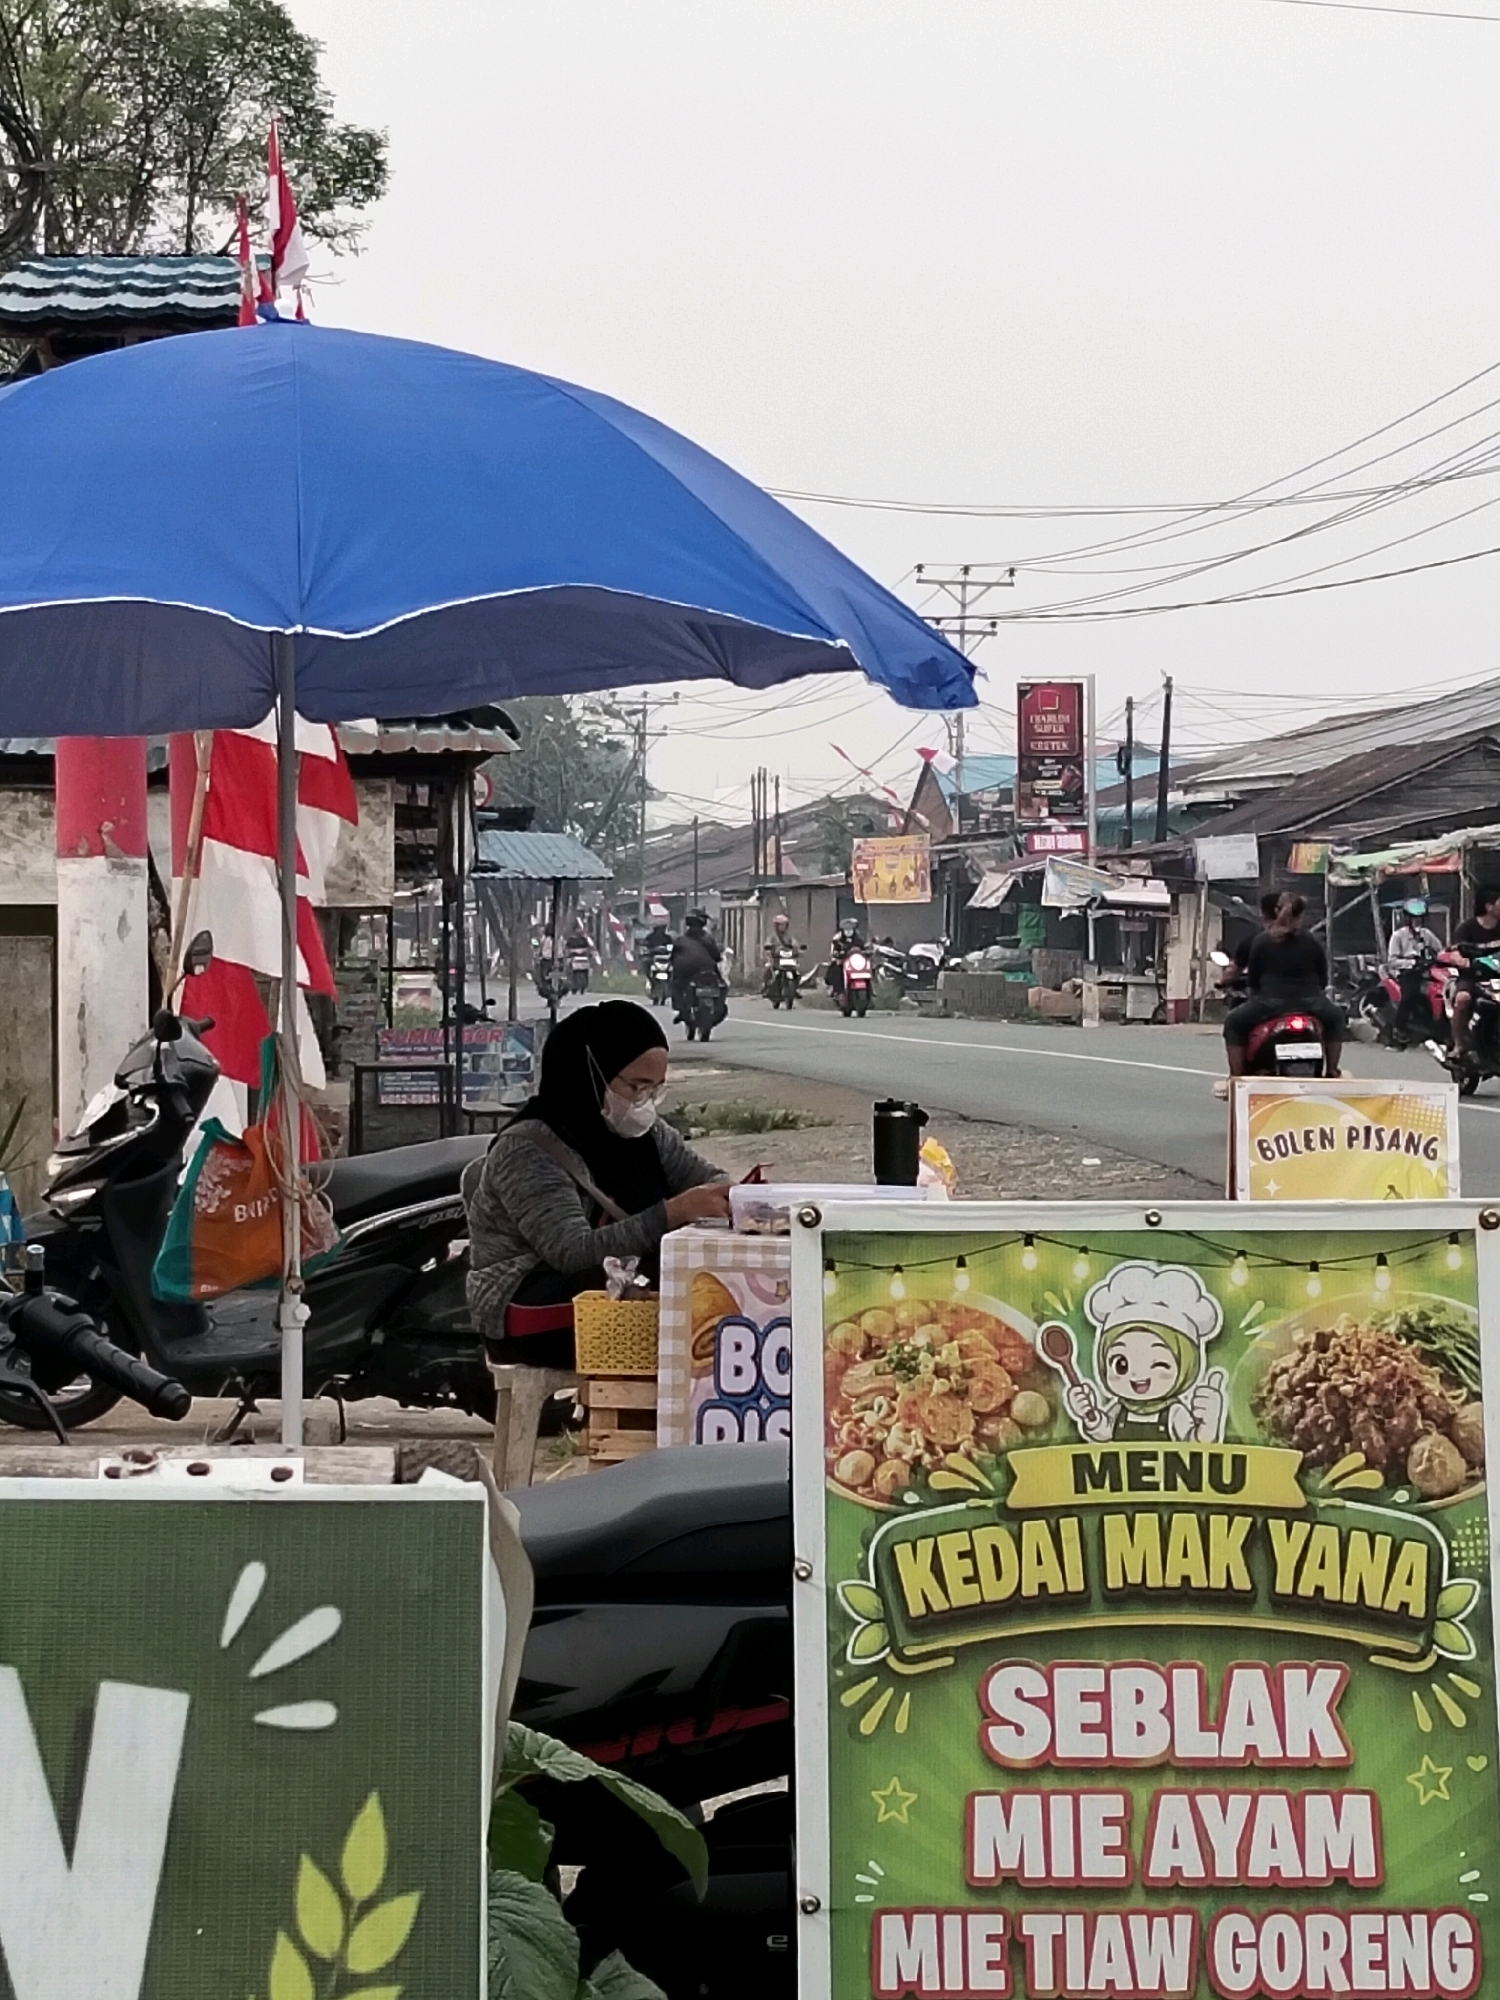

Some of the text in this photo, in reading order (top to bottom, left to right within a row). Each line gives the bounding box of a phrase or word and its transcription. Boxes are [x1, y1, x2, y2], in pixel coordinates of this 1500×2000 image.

[1256, 1125, 1439, 1161] BOLEN PISANG
[1071, 1451, 1248, 1495] MENU
[893, 1513, 1430, 1619] KEDAI MAK YANA
[984, 1664, 1349, 1763] SEBLAK
[971, 1793, 1379, 1880] MIE AYAM
[878, 1911, 1476, 1995] MIE TIAW GORENG
